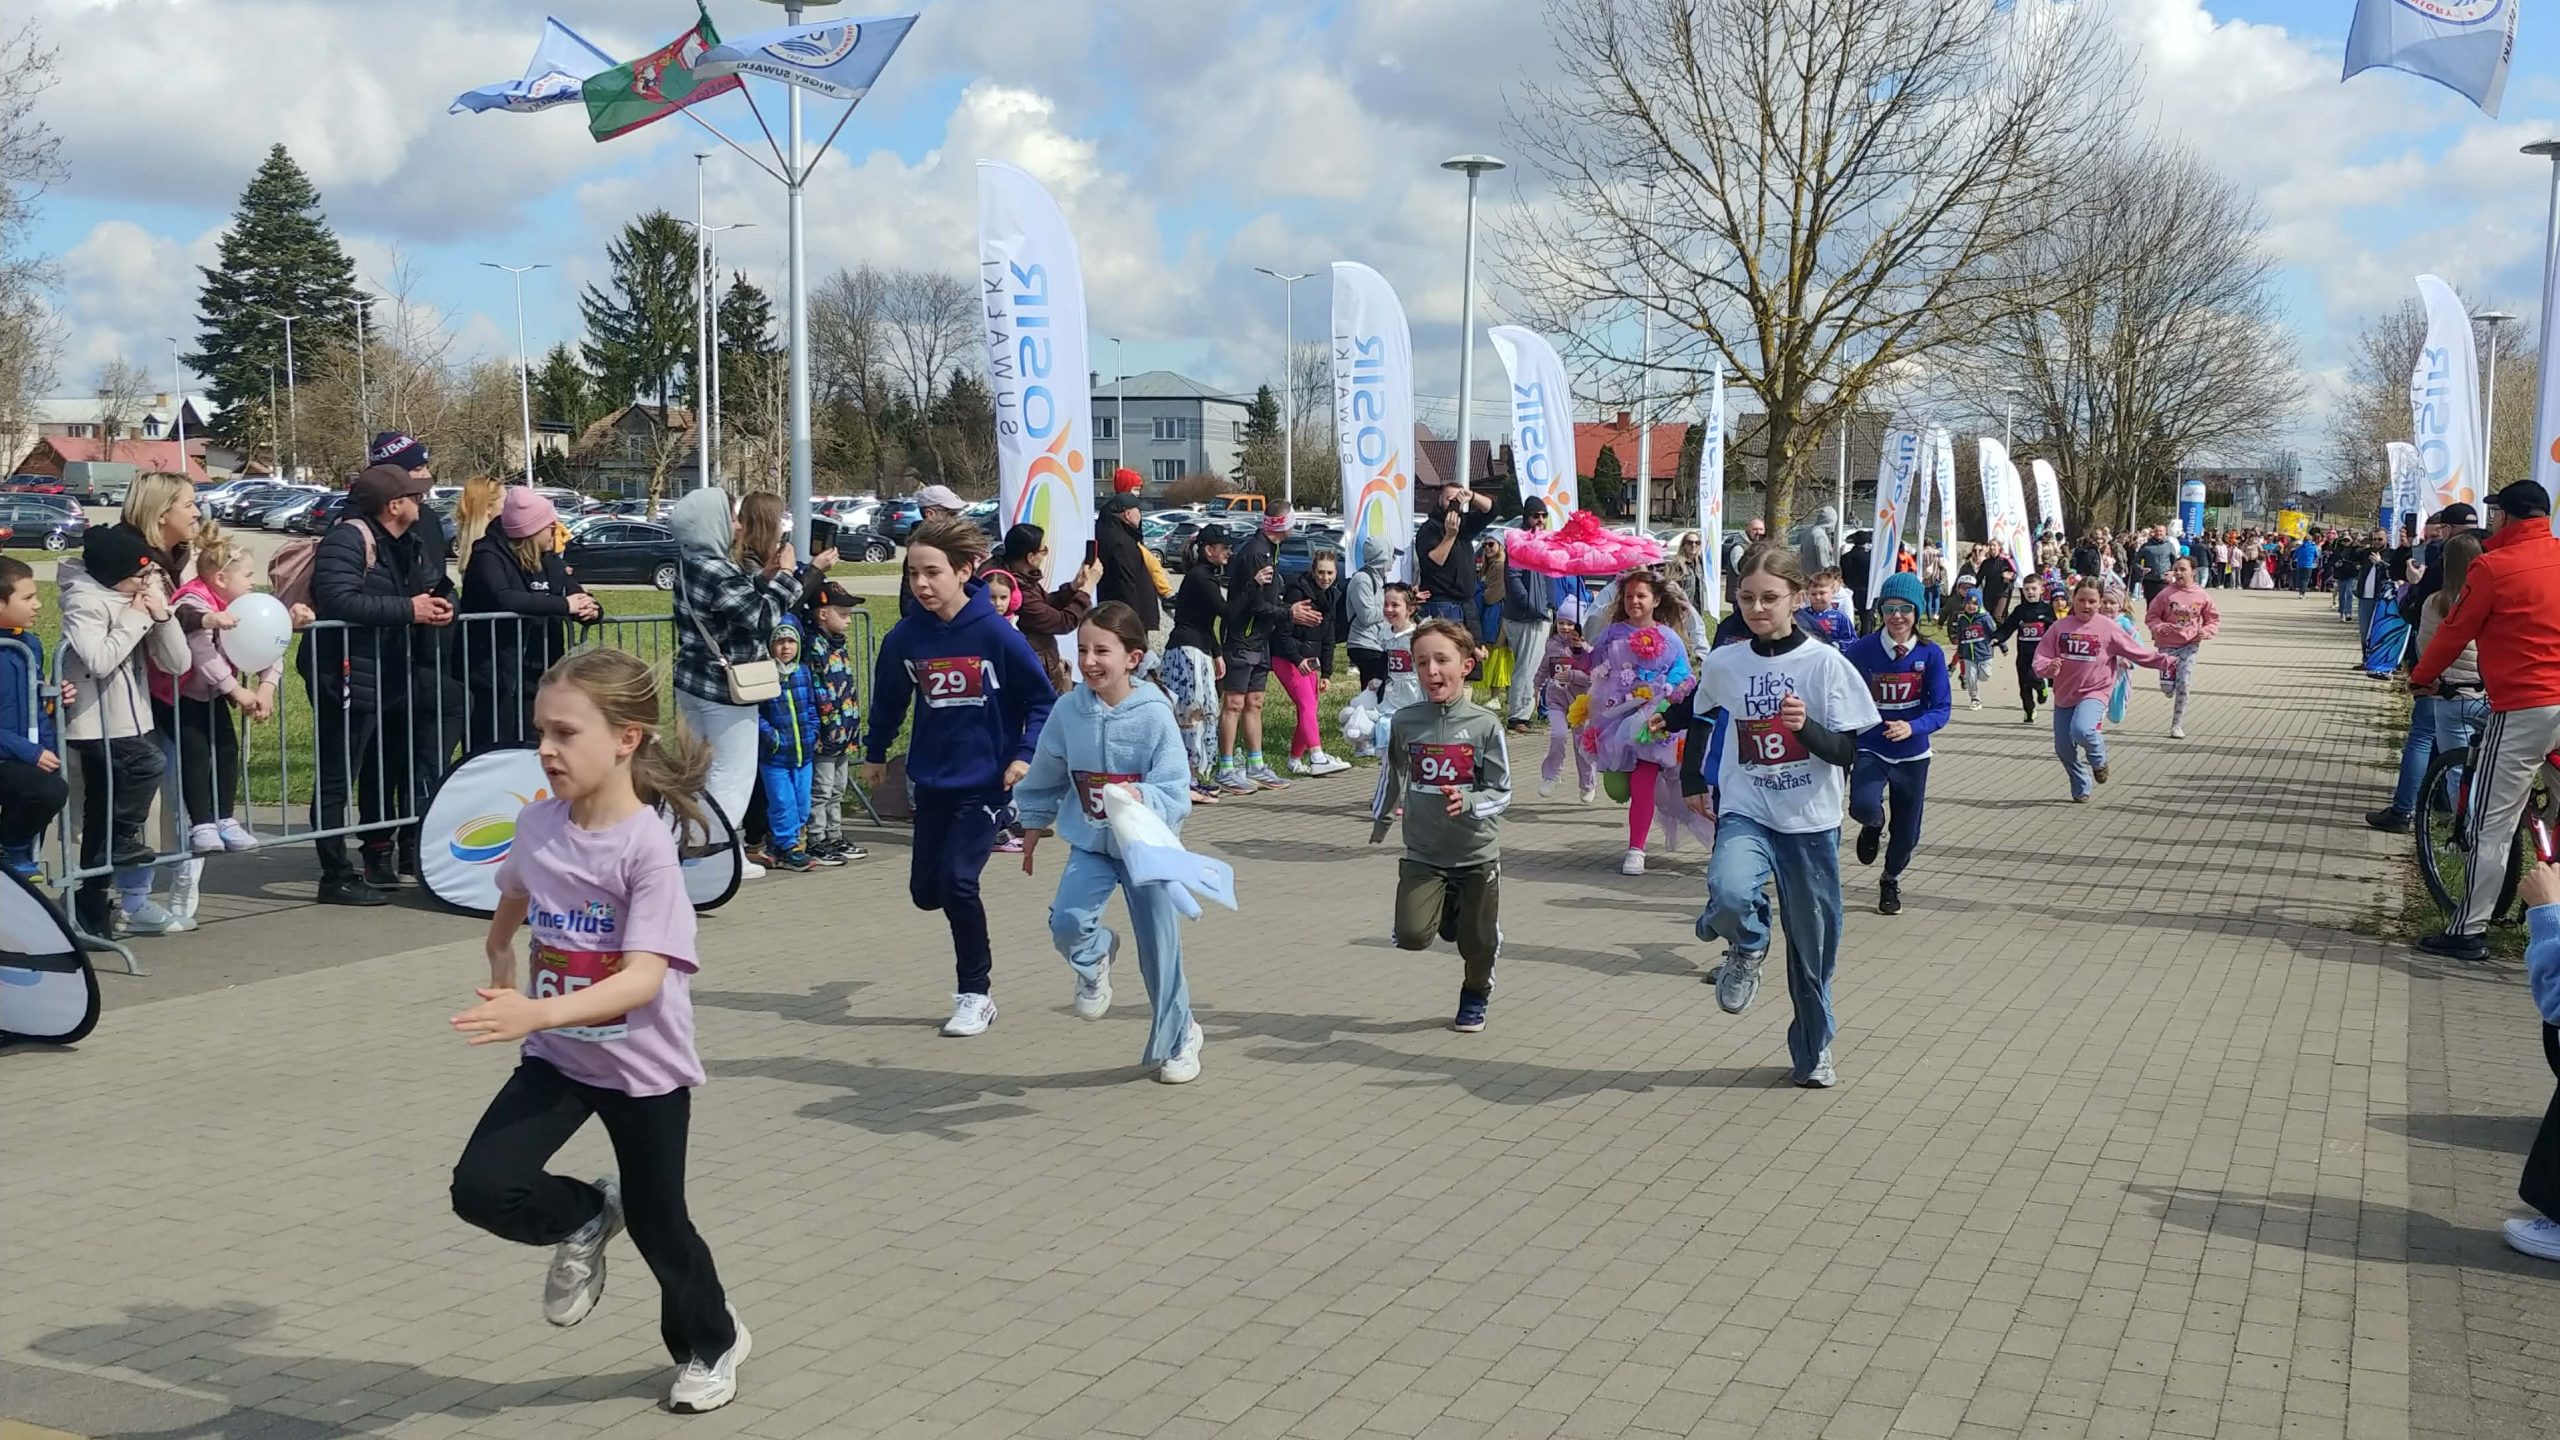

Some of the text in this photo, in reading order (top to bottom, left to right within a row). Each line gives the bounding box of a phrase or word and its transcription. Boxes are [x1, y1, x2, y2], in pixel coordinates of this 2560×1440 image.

[388, 436, 413, 453] Bull
[1965, 629, 1978, 639] 96
[2023, 627, 2038, 637] 99
[2067, 640, 2090, 654] 112
[1389, 656, 1403, 670] 53
[929, 671, 967, 696] 29
[1748, 671, 1795, 697] Life's
[1879, 682, 1912, 700] 117
[1745, 694, 1783, 717] bett
[1752, 733, 1786, 760] 18
[1421, 757, 1458, 781] 94
[537, 909, 615, 933] melius
